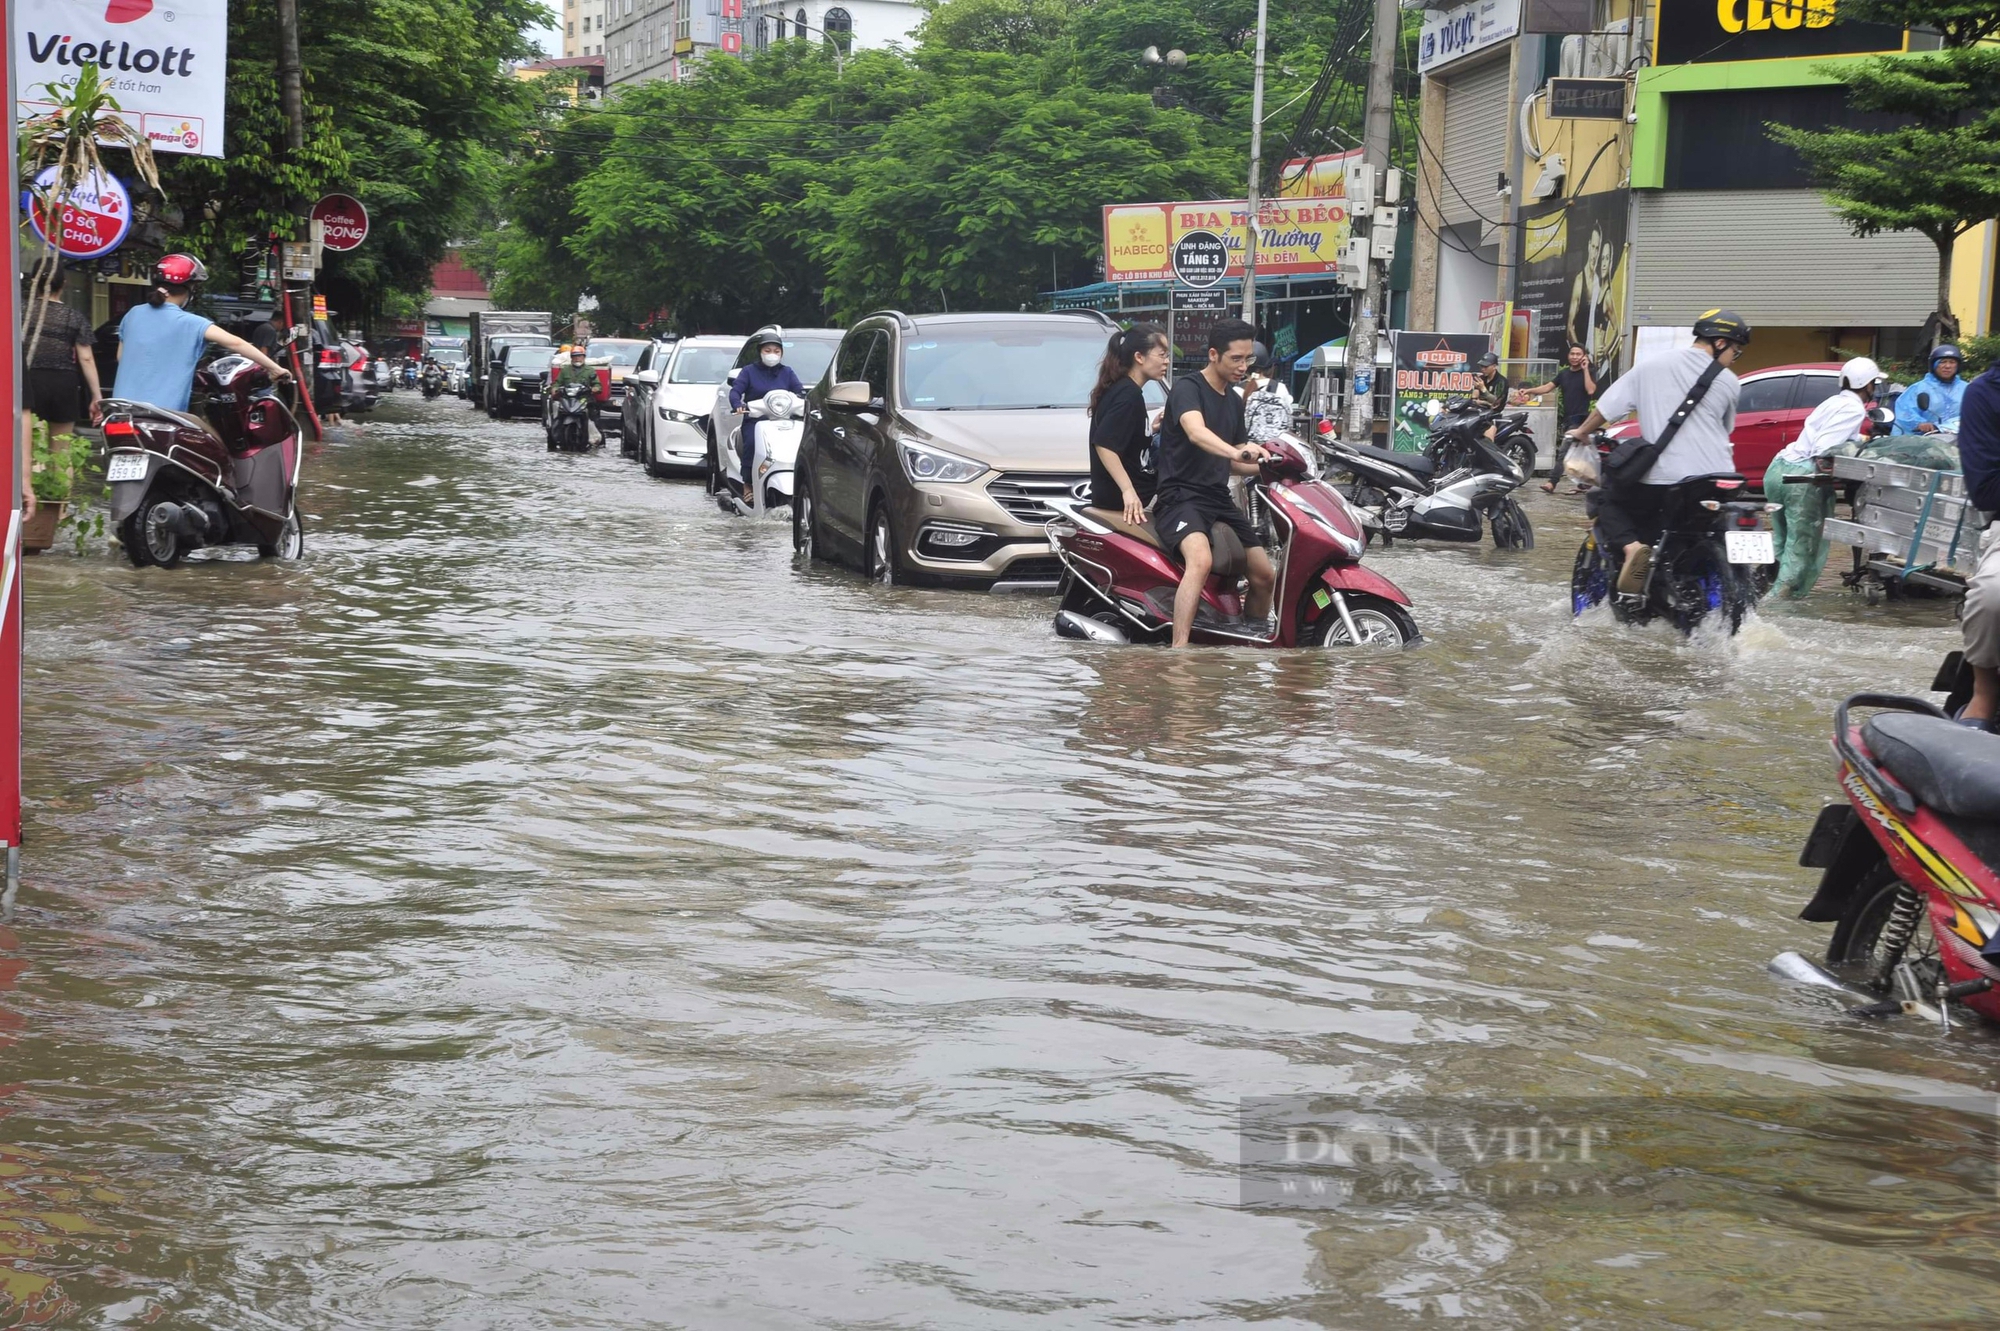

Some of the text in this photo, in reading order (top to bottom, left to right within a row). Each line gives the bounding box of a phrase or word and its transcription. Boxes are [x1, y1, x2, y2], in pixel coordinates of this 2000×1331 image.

[1717, 0, 1836, 34] CLUB
[27, 32, 195, 77] Vietlott
[118, 79, 137, 92] tốt
[138, 80, 161, 94] hơn
[148, 132, 181, 143] Mega
[324, 214, 355, 225] Coffee
[1180, 212, 1224, 228] BIA
[1296, 203, 1346, 224] BÉO
[63, 228, 103, 246] CHỌN
[323, 225, 363, 240] RỌNG
[1260, 227, 1323, 253] Nướng
[1113, 244, 1165, 256] HABECO
[1180, 240, 1222, 252] LINH ĐẶNG
[1212, 254, 1220, 265] 3
[1230, 250, 1299, 265] XUÊN ĐÊM
[1148, 271, 1163, 279] KHU
[1431, 353, 1462, 362] CLUB
[109, 467, 142, 479] 359.61
[1843, 772, 1878, 810] Wave
